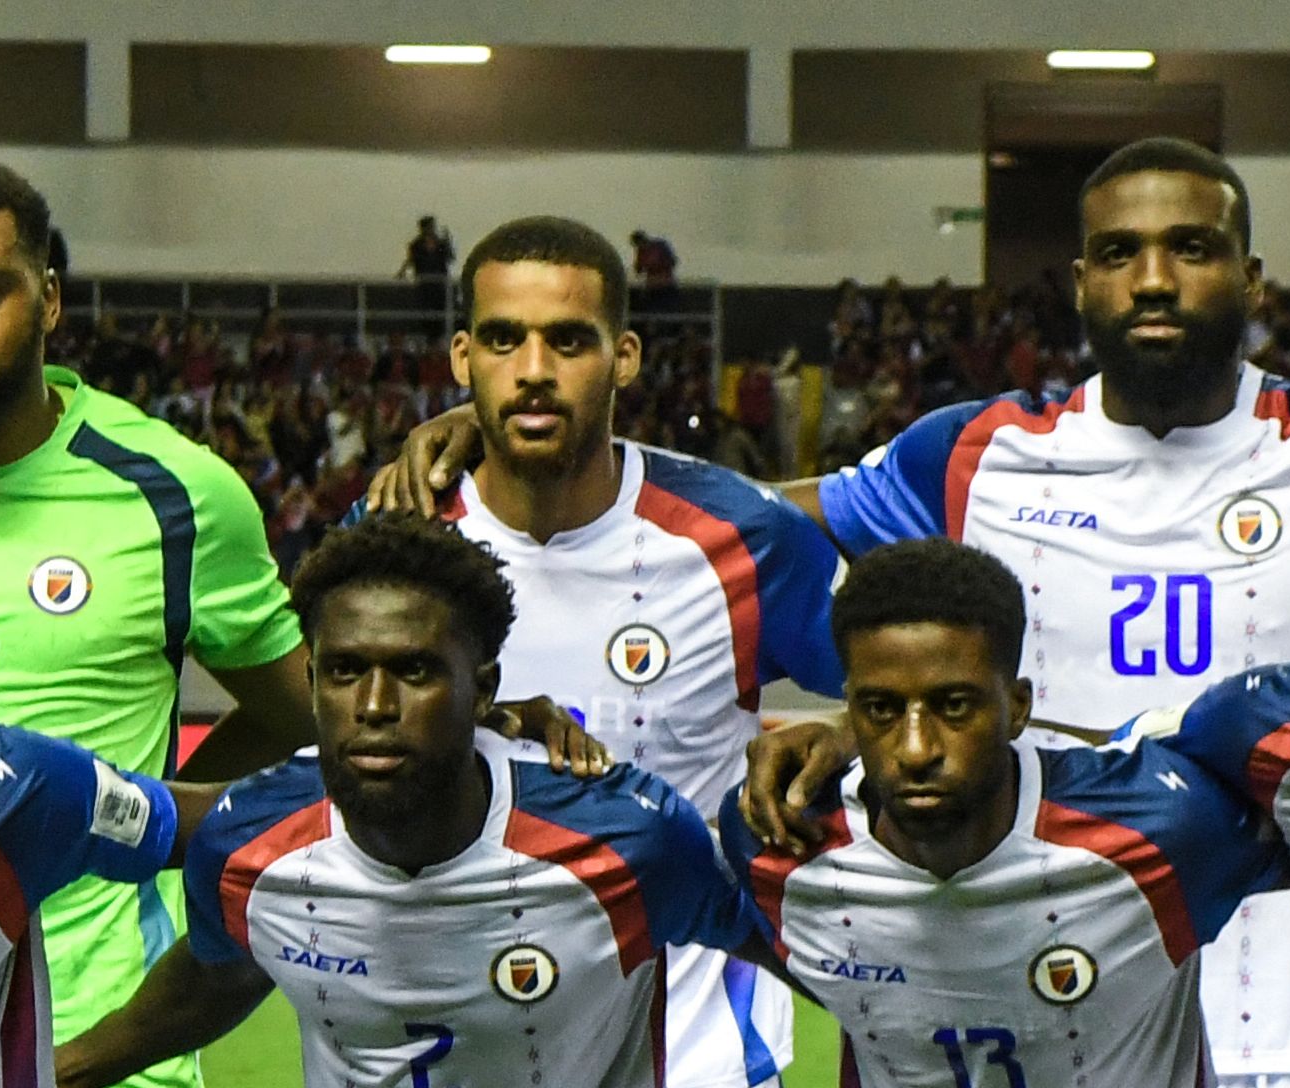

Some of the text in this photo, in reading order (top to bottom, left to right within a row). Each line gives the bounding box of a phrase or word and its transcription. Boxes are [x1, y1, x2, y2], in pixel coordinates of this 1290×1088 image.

[1010, 507, 1098, 530] SAETA
[1110, 574, 1212, 676] 20
[276, 946, 368, 977] SAETA
[820, 959, 907, 983] SAETA
